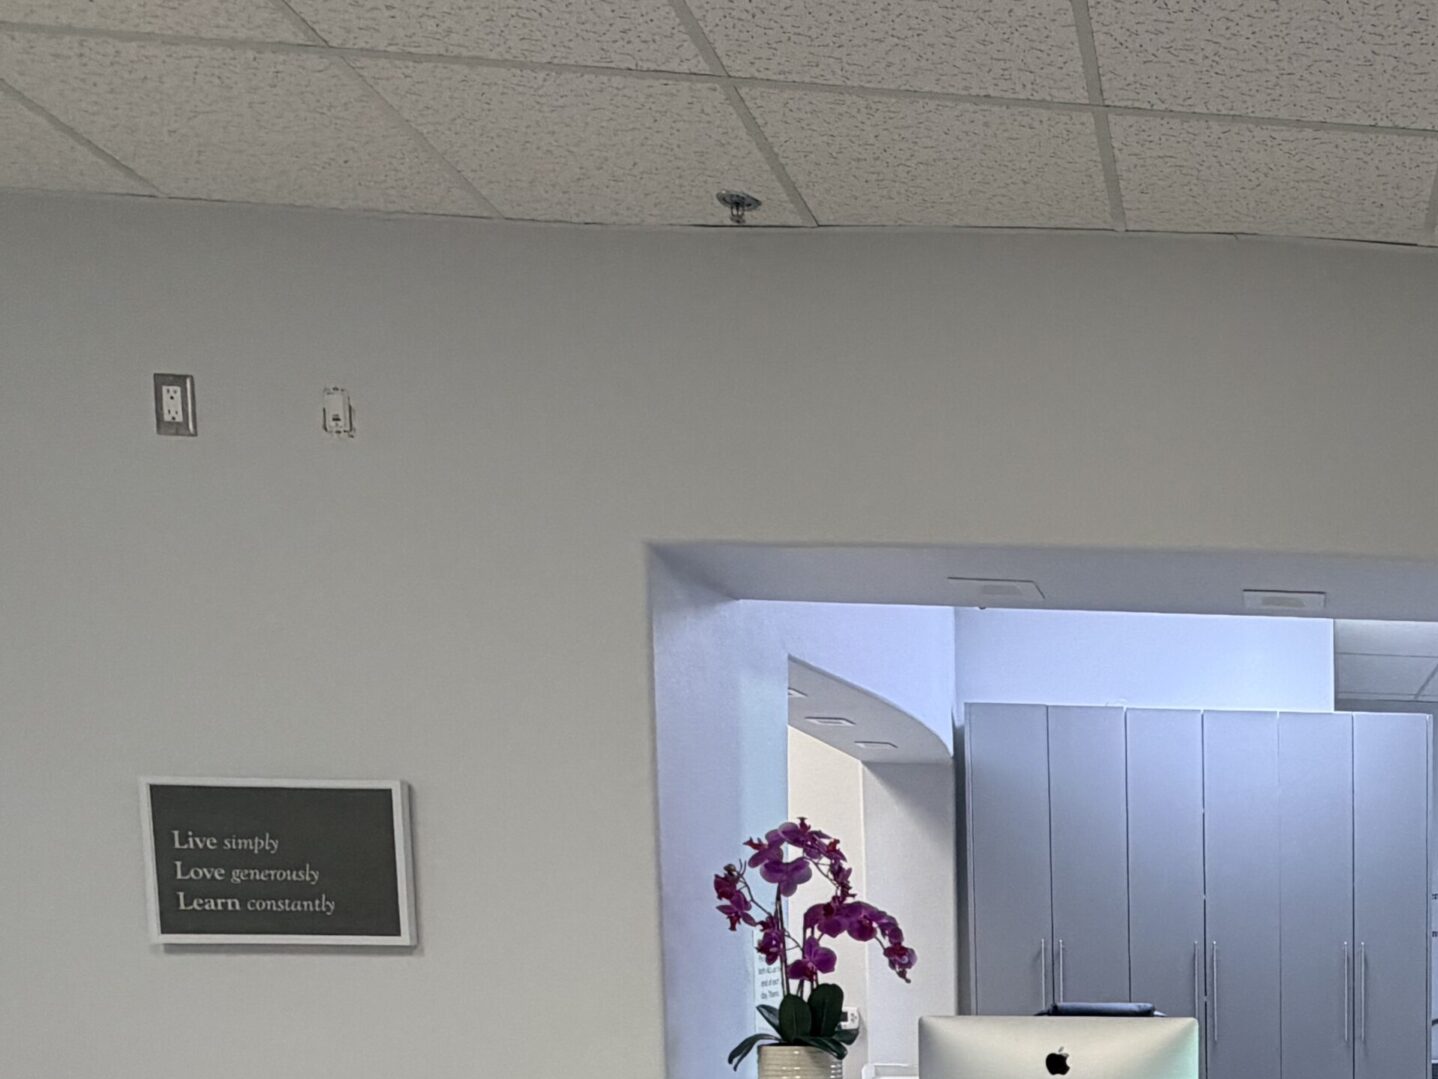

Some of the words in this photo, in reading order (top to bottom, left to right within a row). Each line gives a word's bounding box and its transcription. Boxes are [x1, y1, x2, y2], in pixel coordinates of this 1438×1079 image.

[171, 829, 218, 850] Live
[223, 832, 279, 854] simply
[174, 861, 225, 881] Love
[230, 863, 320, 885] generously
[176, 892, 241, 911] Learn
[247, 894, 336, 916] constantly
